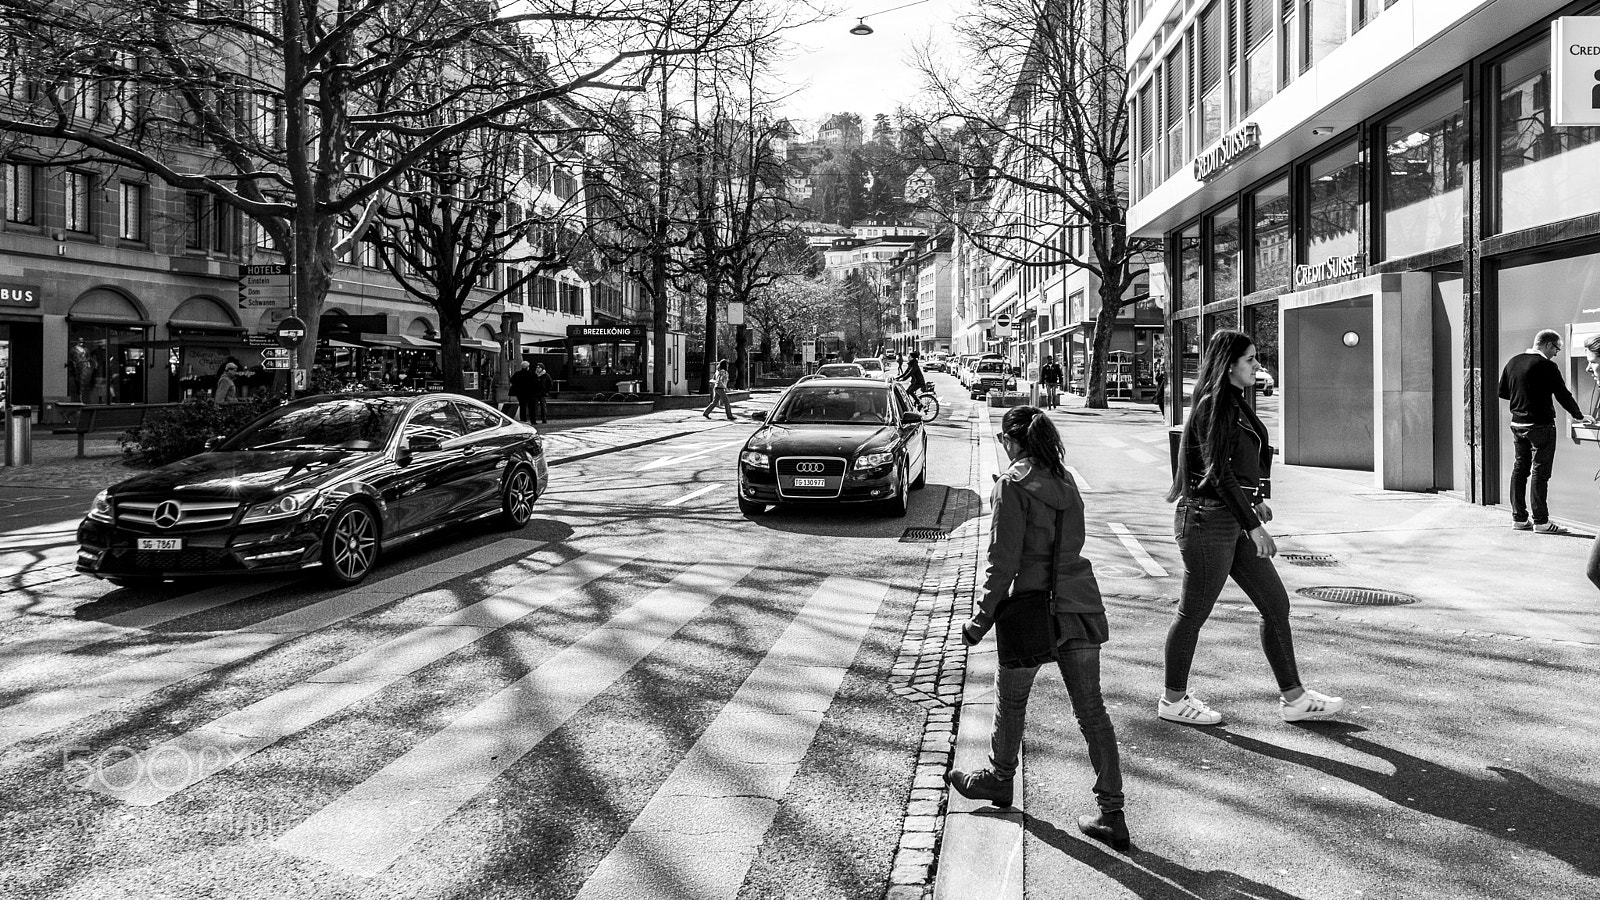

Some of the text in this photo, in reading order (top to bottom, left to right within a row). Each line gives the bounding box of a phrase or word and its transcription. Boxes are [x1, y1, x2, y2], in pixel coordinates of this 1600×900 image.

[1194, 126, 1250, 181] CREDIT SUISSE
[247, 265, 282, 275] HOTELS
[1296, 254, 1358, 286] CREDIT SUISSE
[247, 277, 270, 285] Einstein
[0, 288, 33, 302] BUS
[247, 288, 261, 296] Dom
[247, 299, 276, 307] Schwanen
[583, 327, 631, 336] BREZELKÖNIG
